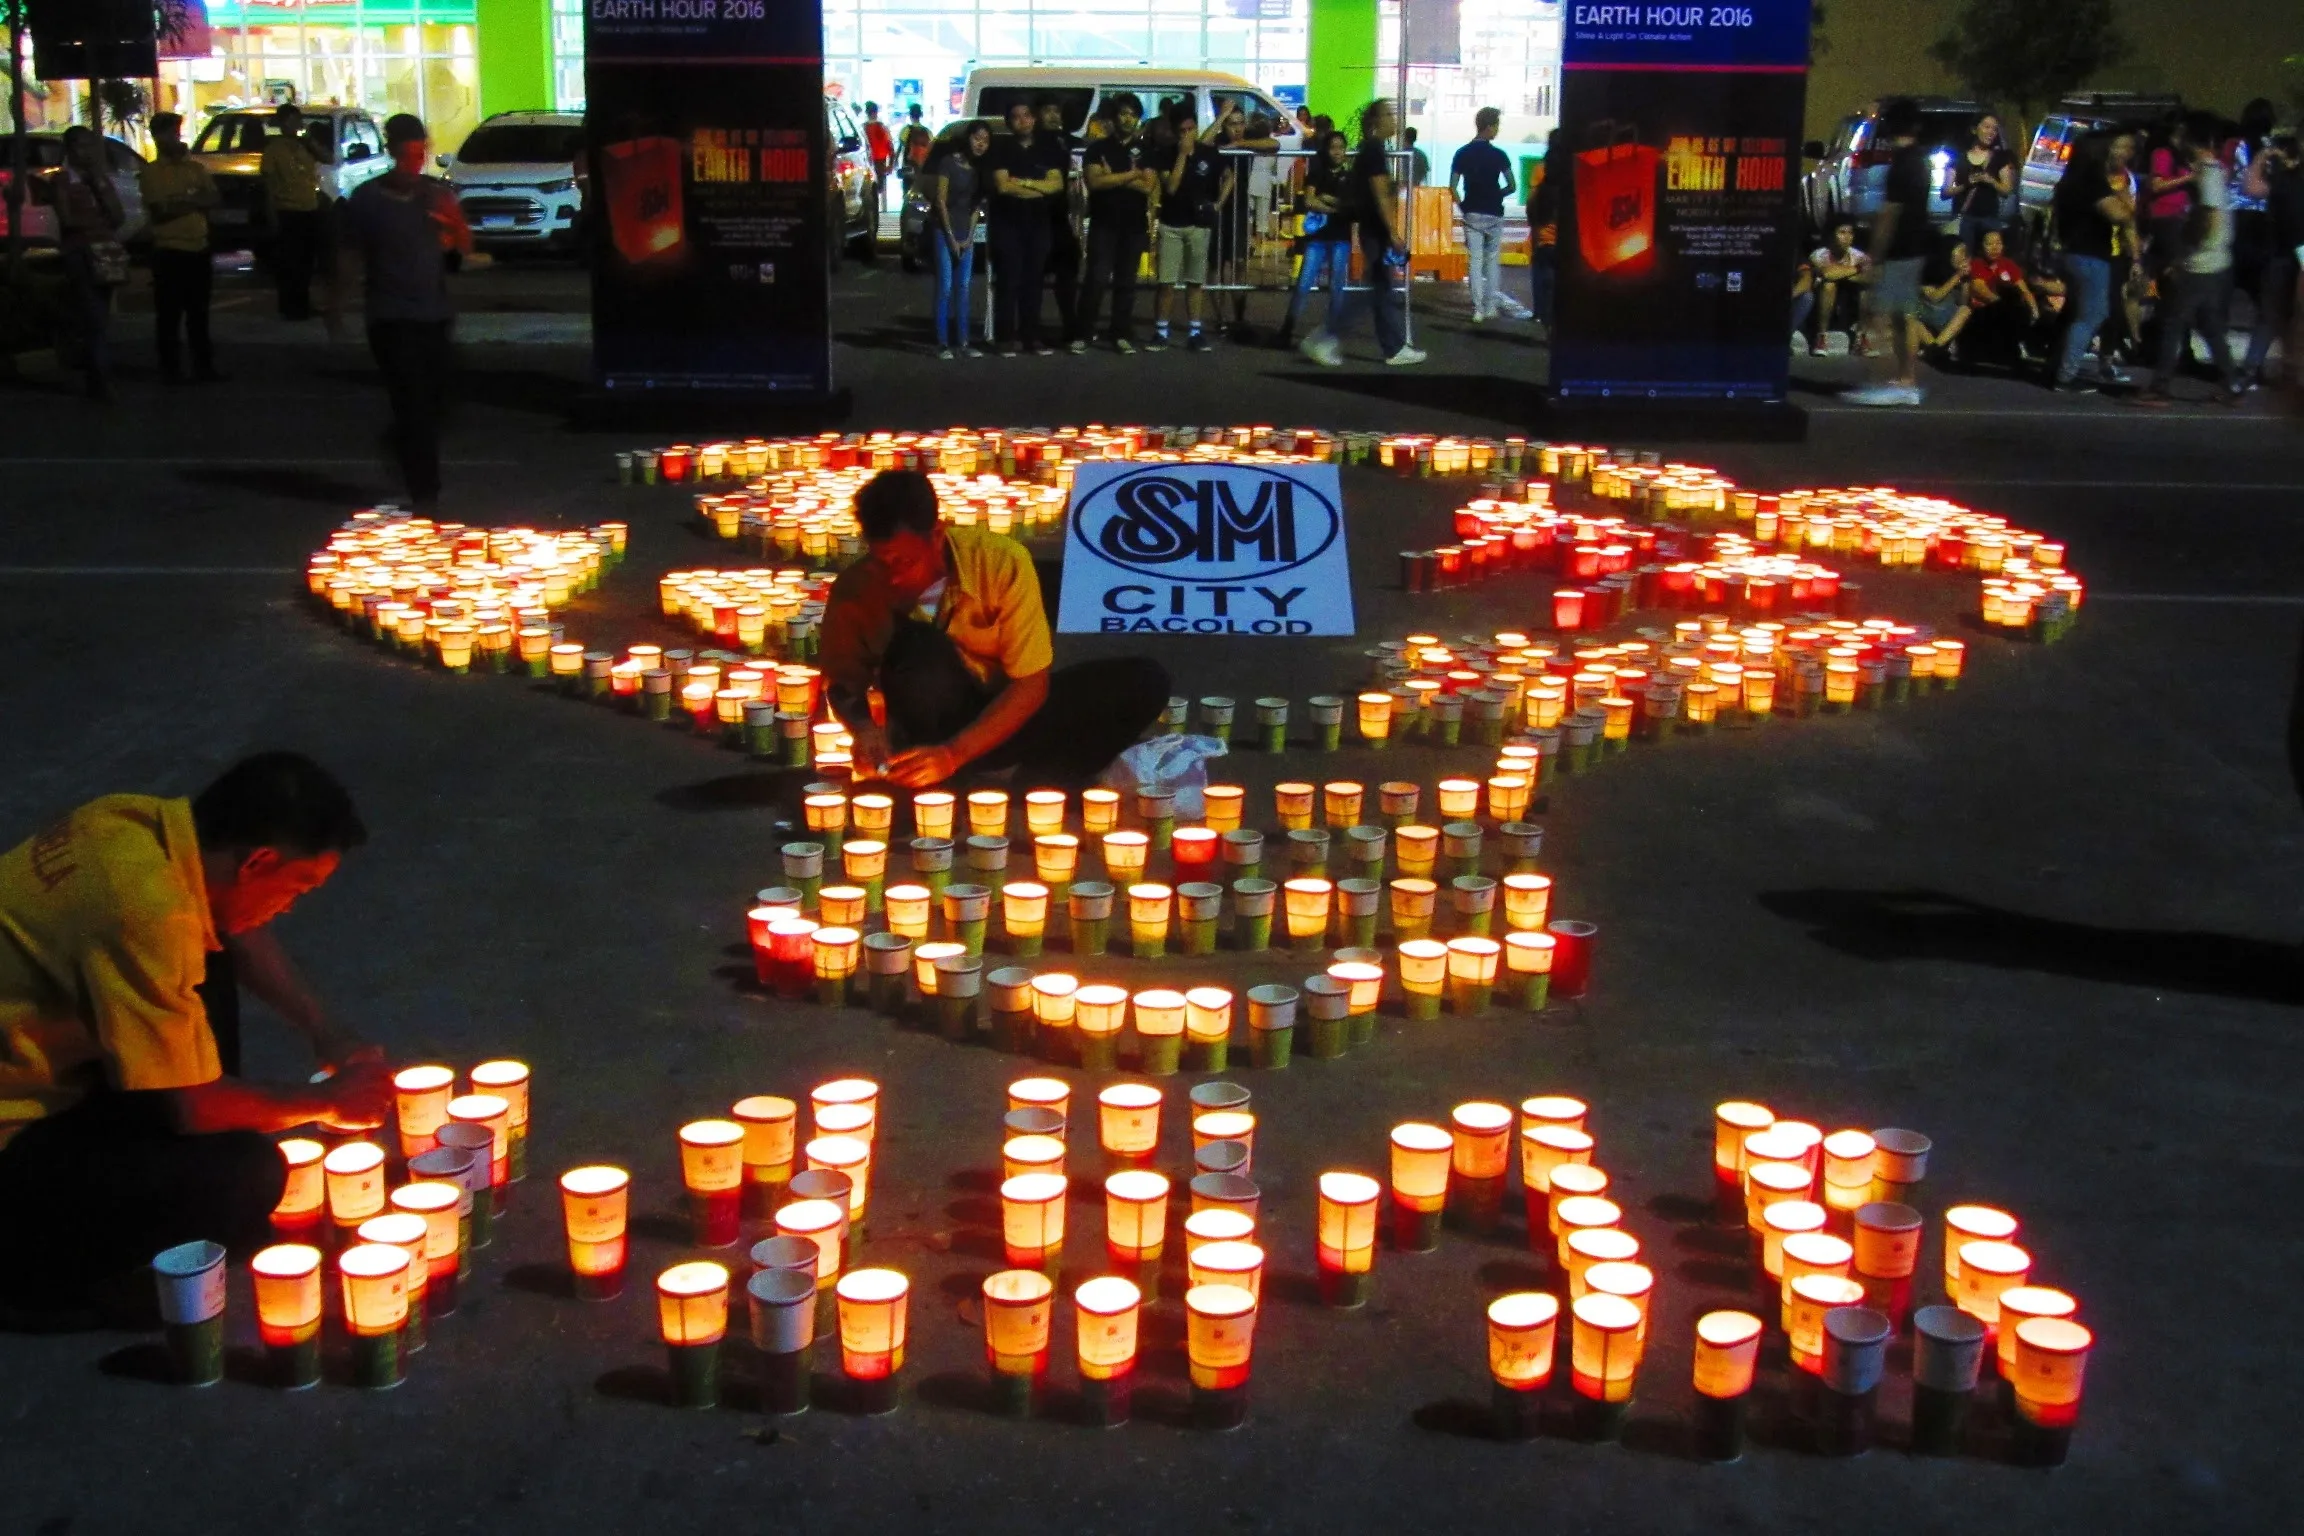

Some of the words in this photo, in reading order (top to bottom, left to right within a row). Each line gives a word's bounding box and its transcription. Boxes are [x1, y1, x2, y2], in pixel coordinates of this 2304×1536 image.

[593, 0, 655, 18] EARTH
[662, 0, 716, 18] HOUR
[724, 0, 765, 19] 2016
[1575, 6, 1640, 25] EARTH
[1647, 7, 1703, 26] HOUR
[1710, 8, 1752, 27] 2016
[1667, 155, 1725, 191] EARTH
[1736, 156, 1785, 191] HOUR
[1100, 476, 1297, 564] SM
[1102, 585, 1307, 617] CITY
[1100, 617, 1313, 635] BACOLOD
